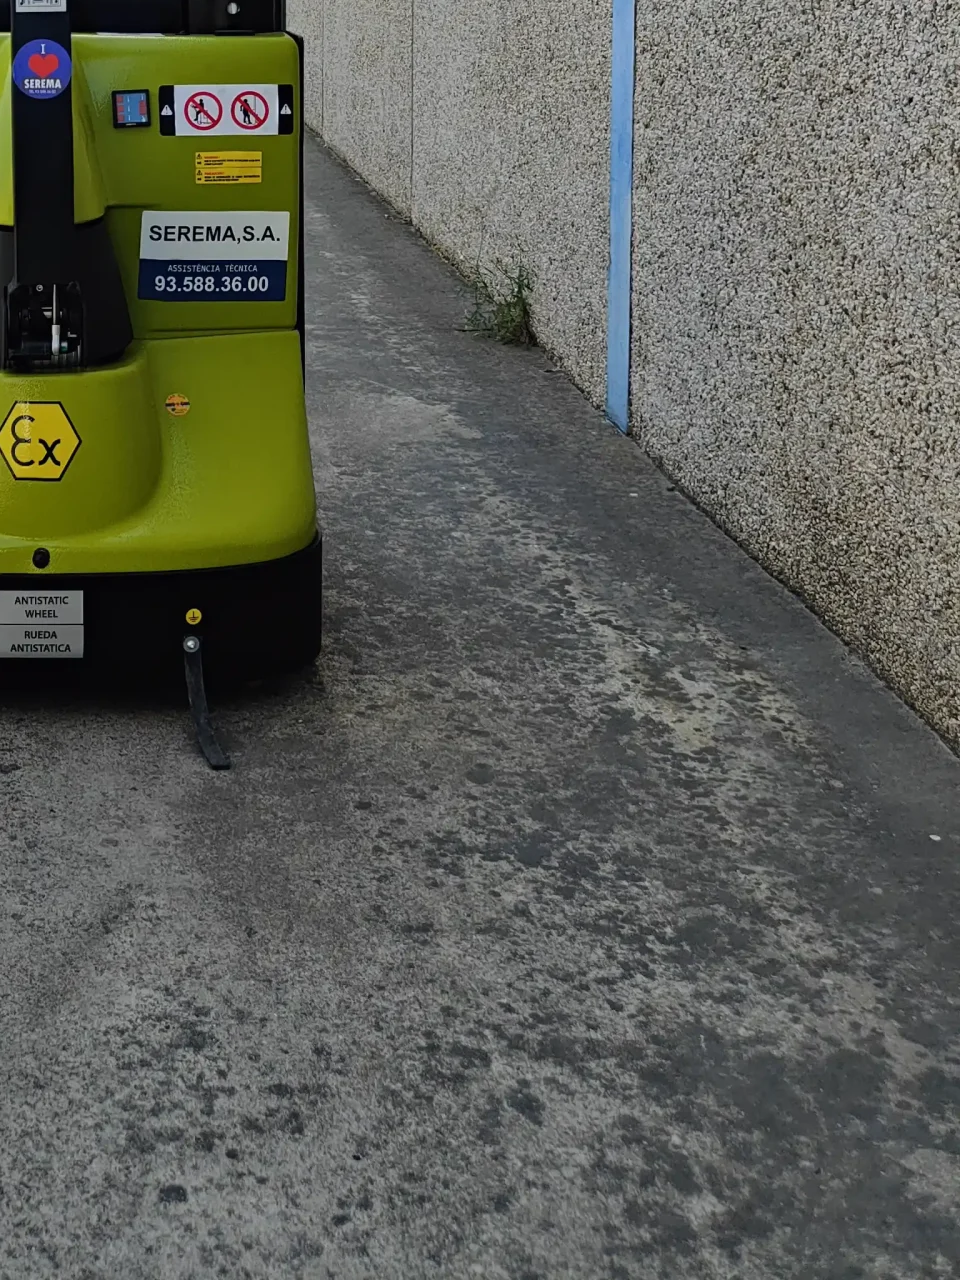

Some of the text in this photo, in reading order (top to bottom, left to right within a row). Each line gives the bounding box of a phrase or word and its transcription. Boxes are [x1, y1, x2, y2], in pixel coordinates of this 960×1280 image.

[40, 43, 46, 55] I
[24, 78, 62, 89] SEREMA
[154, 275, 269, 292] 93.588.36.00
[10, 414, 61, 467] Ex
[14, 596, 69, 605] ANTISTATIC
[24, 609, 59, 619] WHEEL
[24, 630, 58, 640] RUEDA
[9, 643, 72, 653] ANTISTATICA
